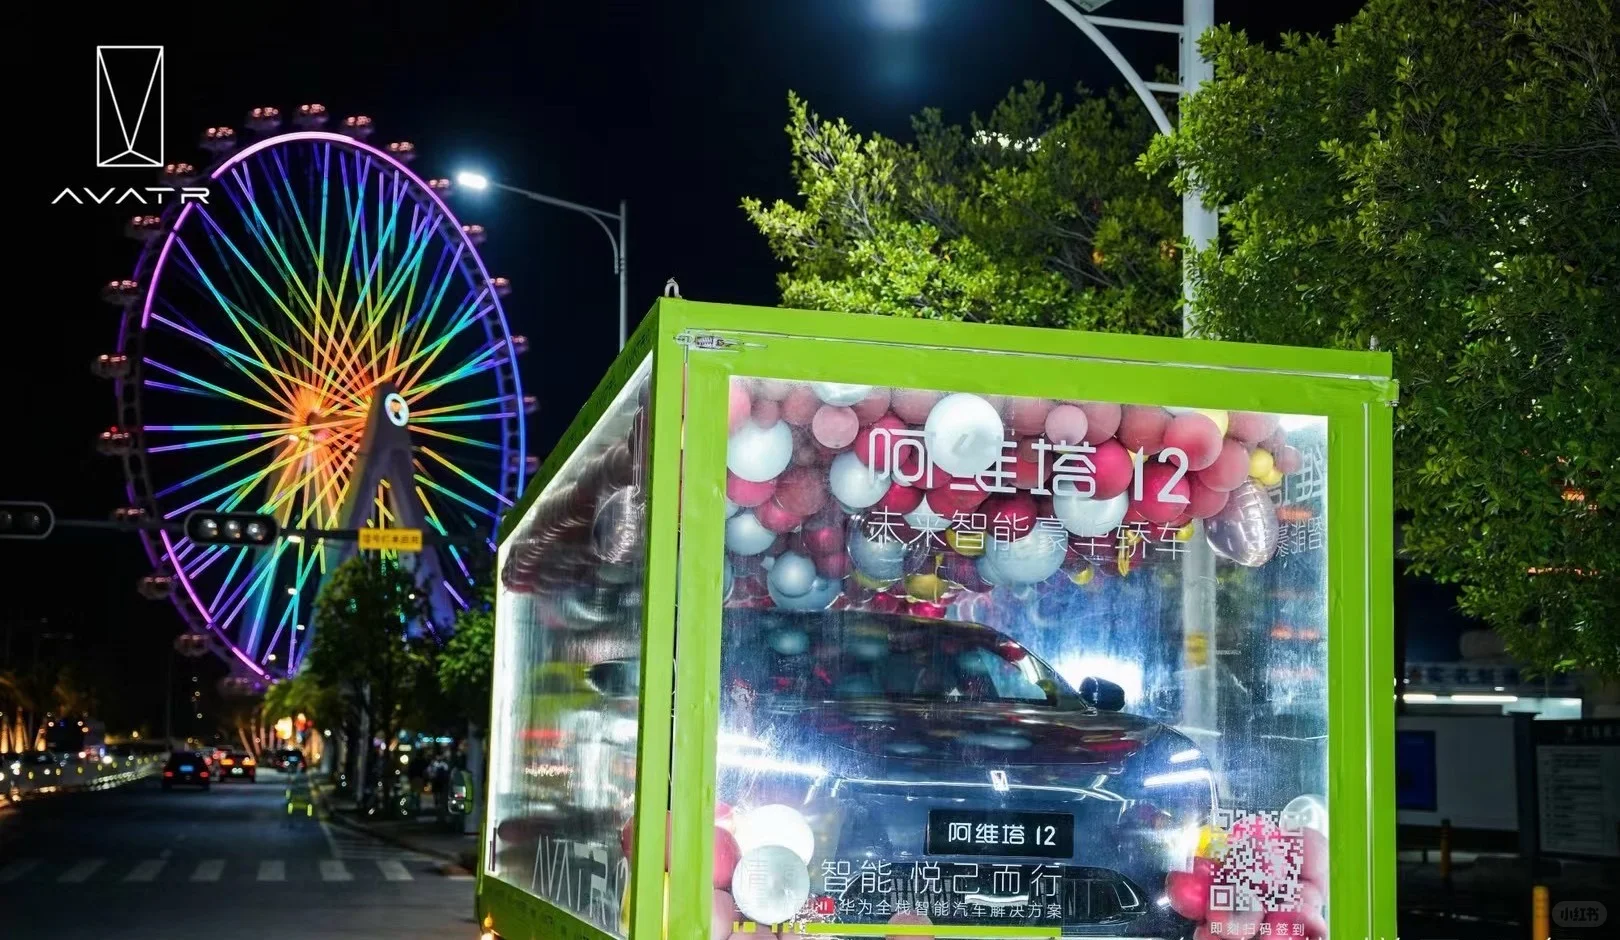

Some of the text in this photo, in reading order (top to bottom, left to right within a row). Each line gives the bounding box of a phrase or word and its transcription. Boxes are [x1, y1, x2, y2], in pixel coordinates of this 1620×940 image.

[869, 428, 1190, 504] 阿维塔 12
[948, 823, 1056, 846] 阿维塔 12
[911, 861, 1063, 897] 悦己而行
[839, 898, 1063, 919] 华为全栈智能汽车解决方案
[1210, 922, 1305, 936] 即刻扫码签到
